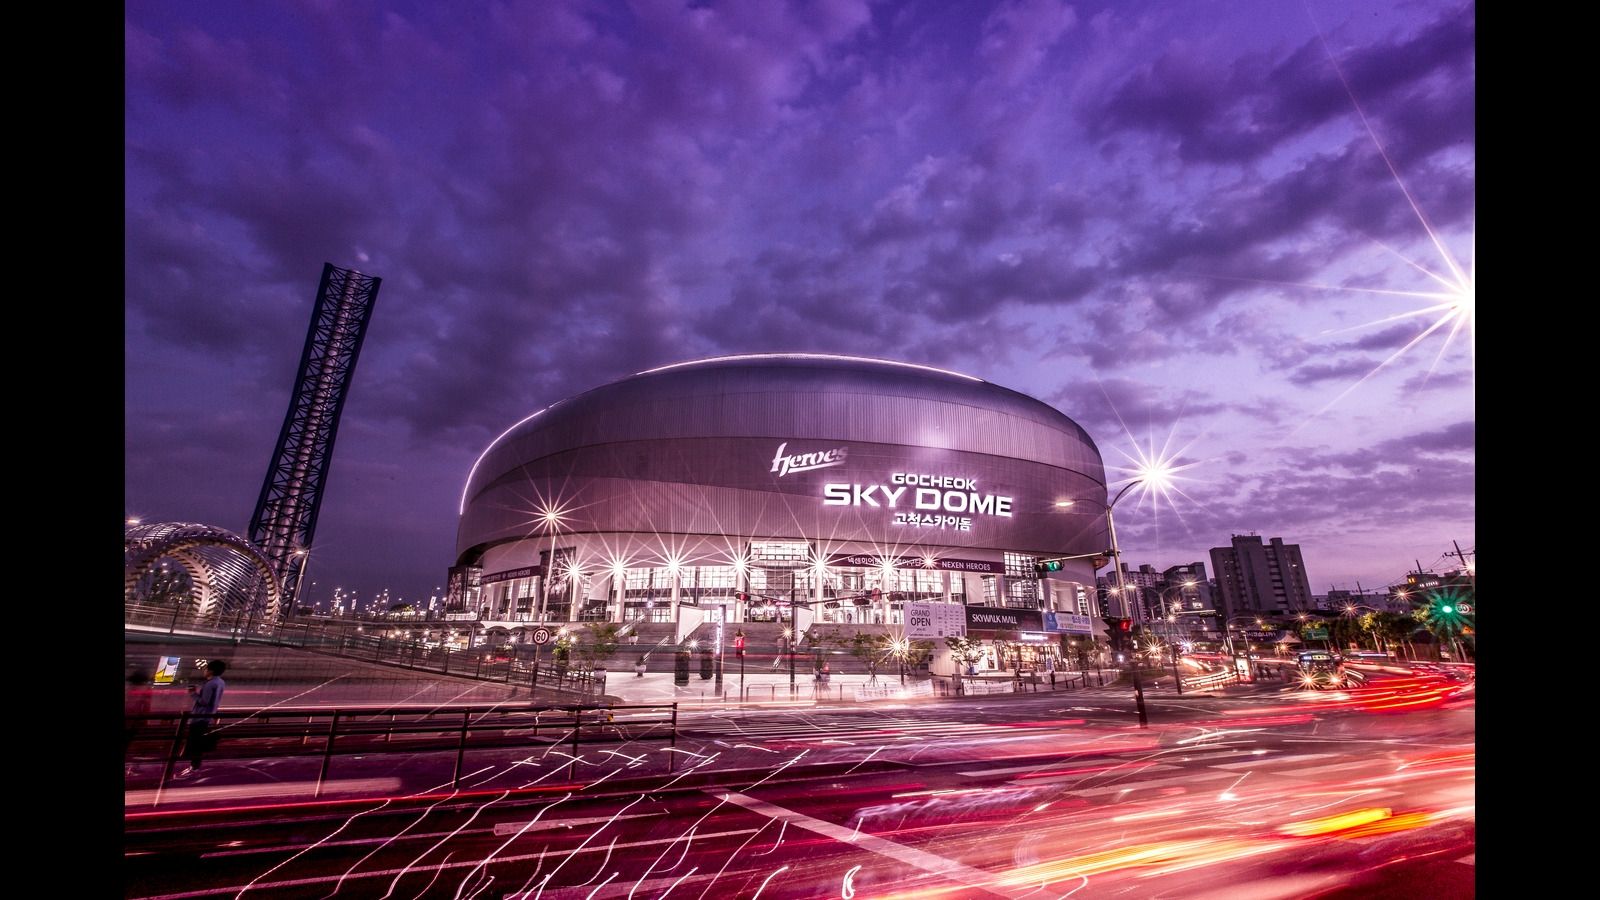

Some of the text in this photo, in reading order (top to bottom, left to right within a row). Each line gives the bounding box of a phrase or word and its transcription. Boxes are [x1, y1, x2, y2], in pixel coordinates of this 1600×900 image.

[770, 442, 848, 477] heroes
[891, 473, 977, 491] GOCHEOK
[823, 483, 1013, 518] SKY DOME
[891, 512, 973, 531] 고척스카이돔
[942, 561, 991, 571] NEXEN HEROES
[910, 609, 931, 617] GRAND
[972, 613, 1018, 624] SKYWALK MALL
[910, 617, 931, 627] OPEN
[535, 631, 546, 641] 60
